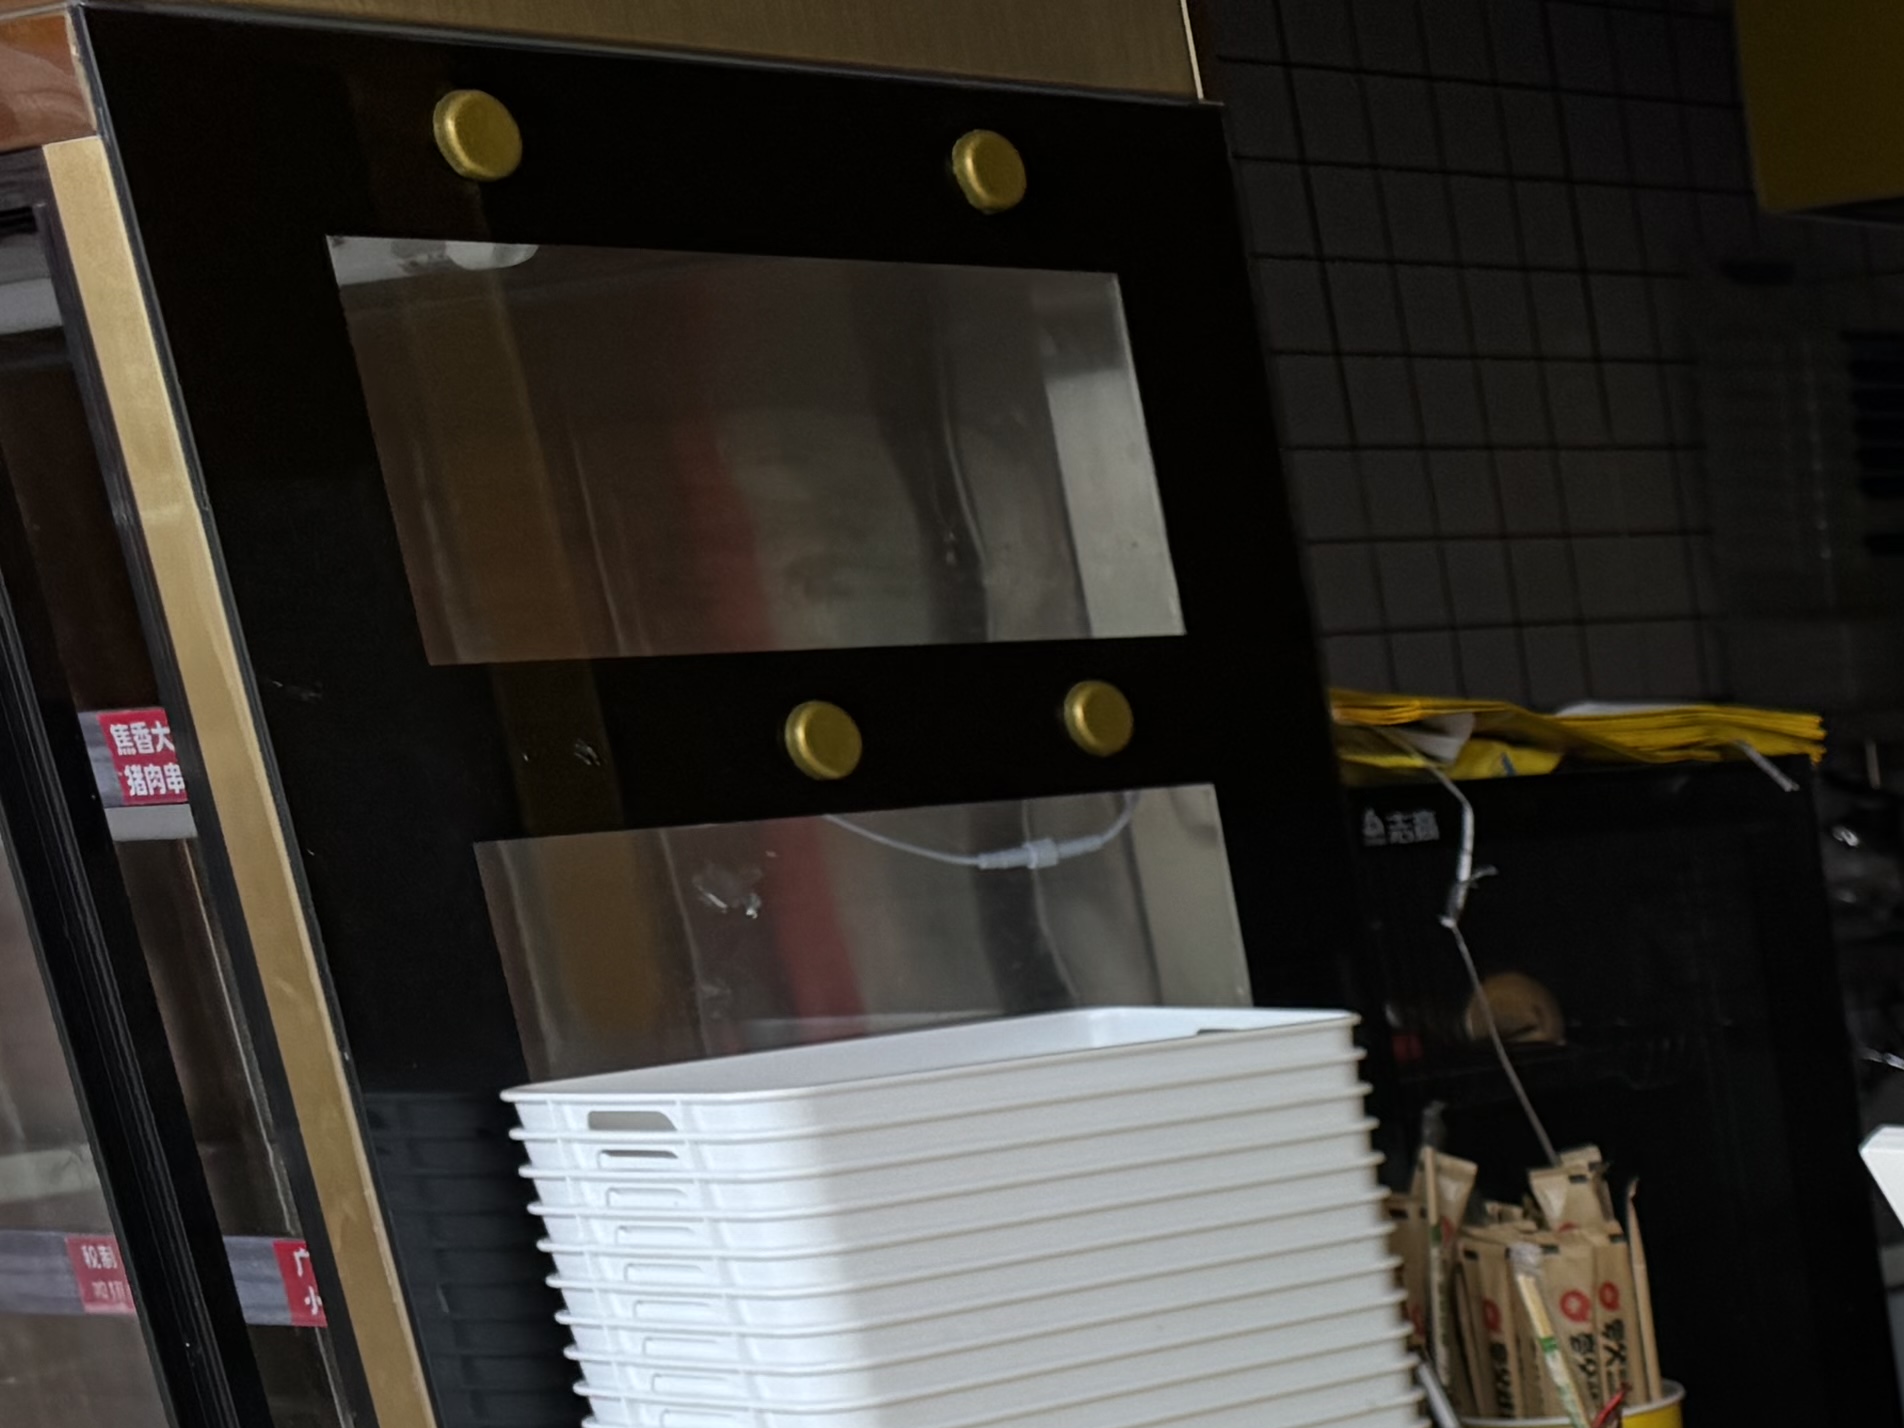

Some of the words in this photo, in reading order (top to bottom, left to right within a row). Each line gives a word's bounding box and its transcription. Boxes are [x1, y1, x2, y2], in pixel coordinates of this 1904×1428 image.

[110, 720, 175, 756] 焦香大
[125, 762, 185, 796] 猪肉串
